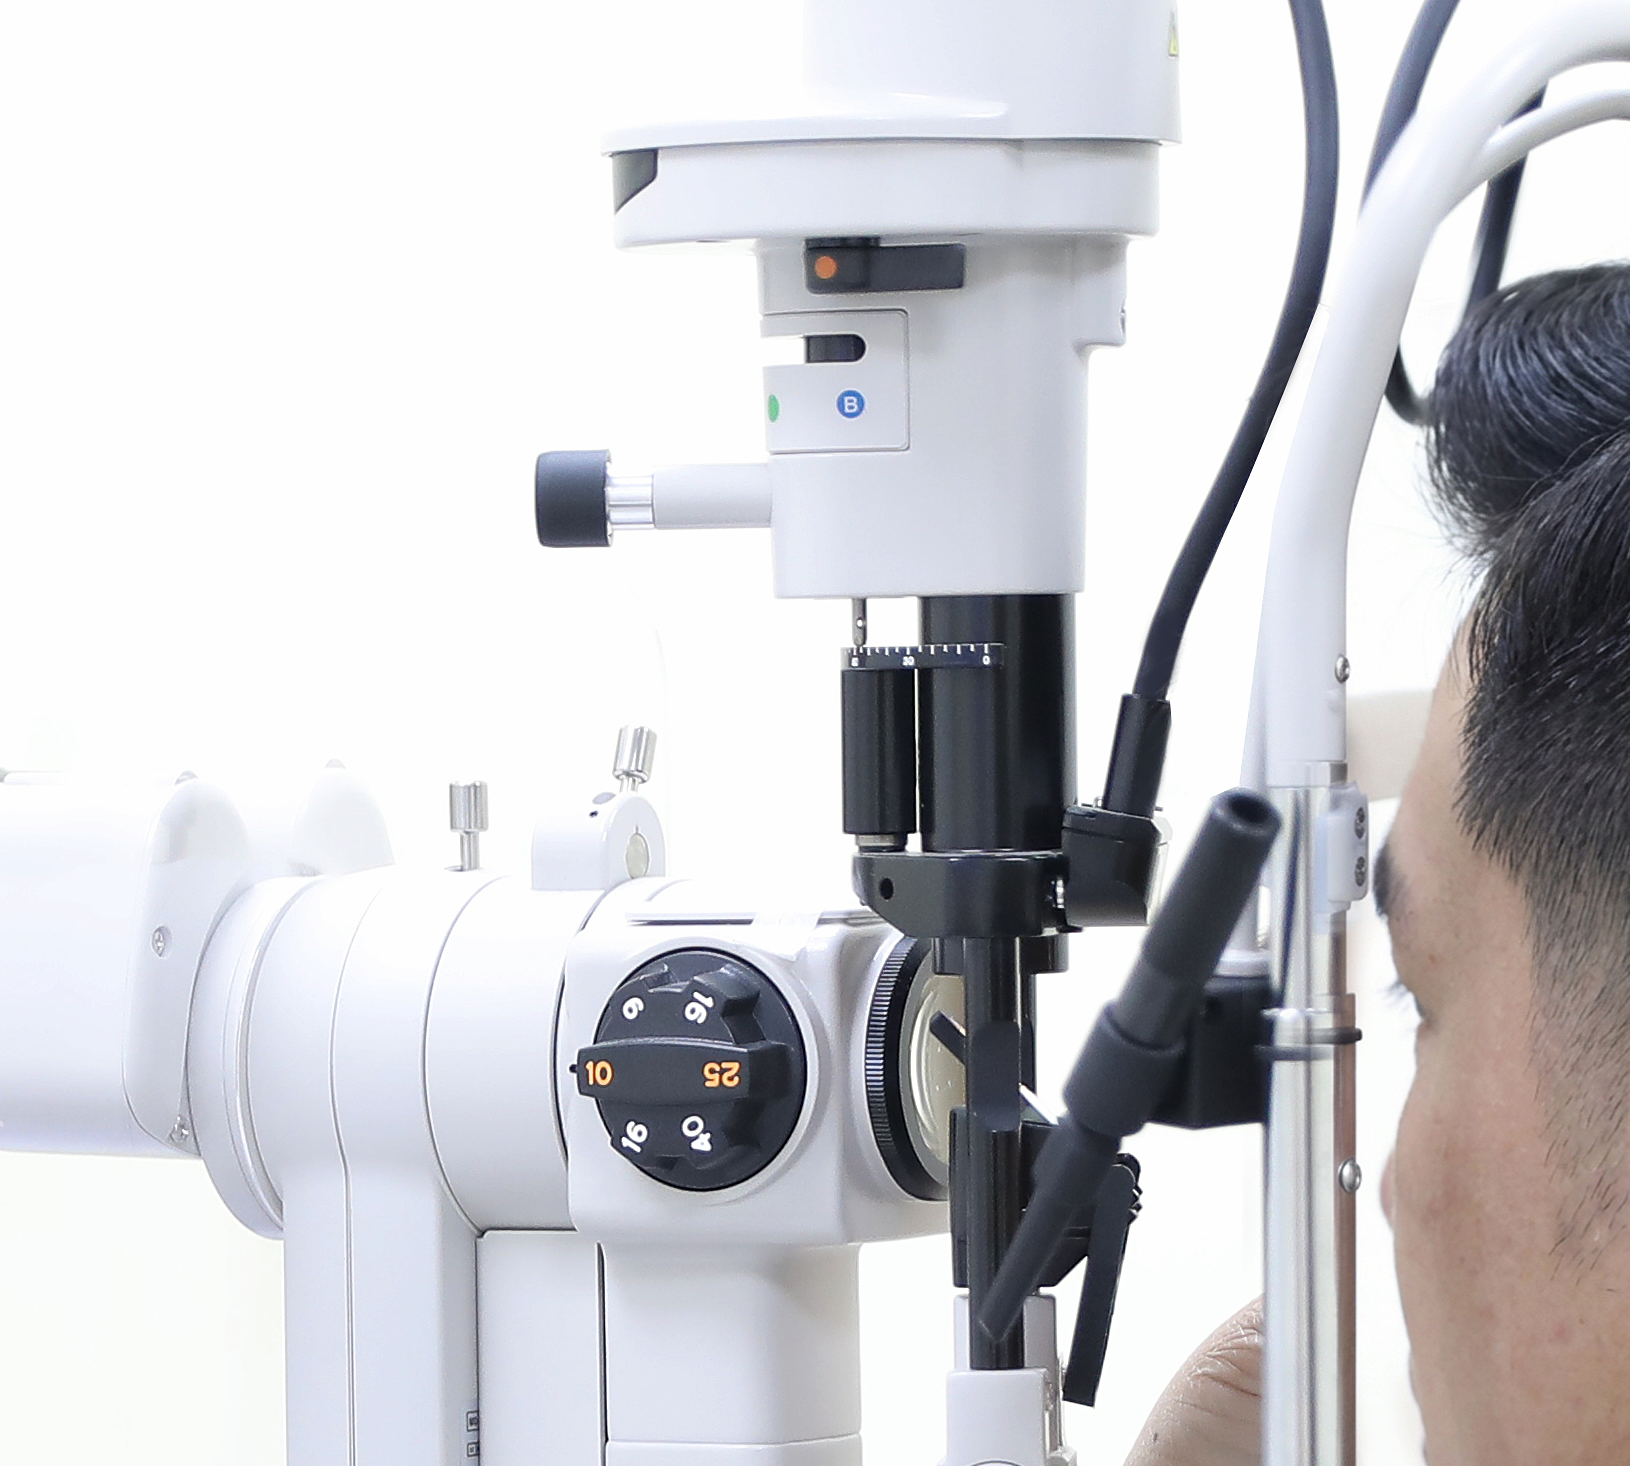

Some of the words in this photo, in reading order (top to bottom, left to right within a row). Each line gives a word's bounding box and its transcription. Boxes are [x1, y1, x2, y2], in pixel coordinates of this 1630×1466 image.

[844, 396, 858, 413] B
[585, 1060, 614, 1086] 10
[703, 1061, 740, 1087] 25
[621, 1120, 648, 1153] 16
[681, 1115, 712, 1151] 40
